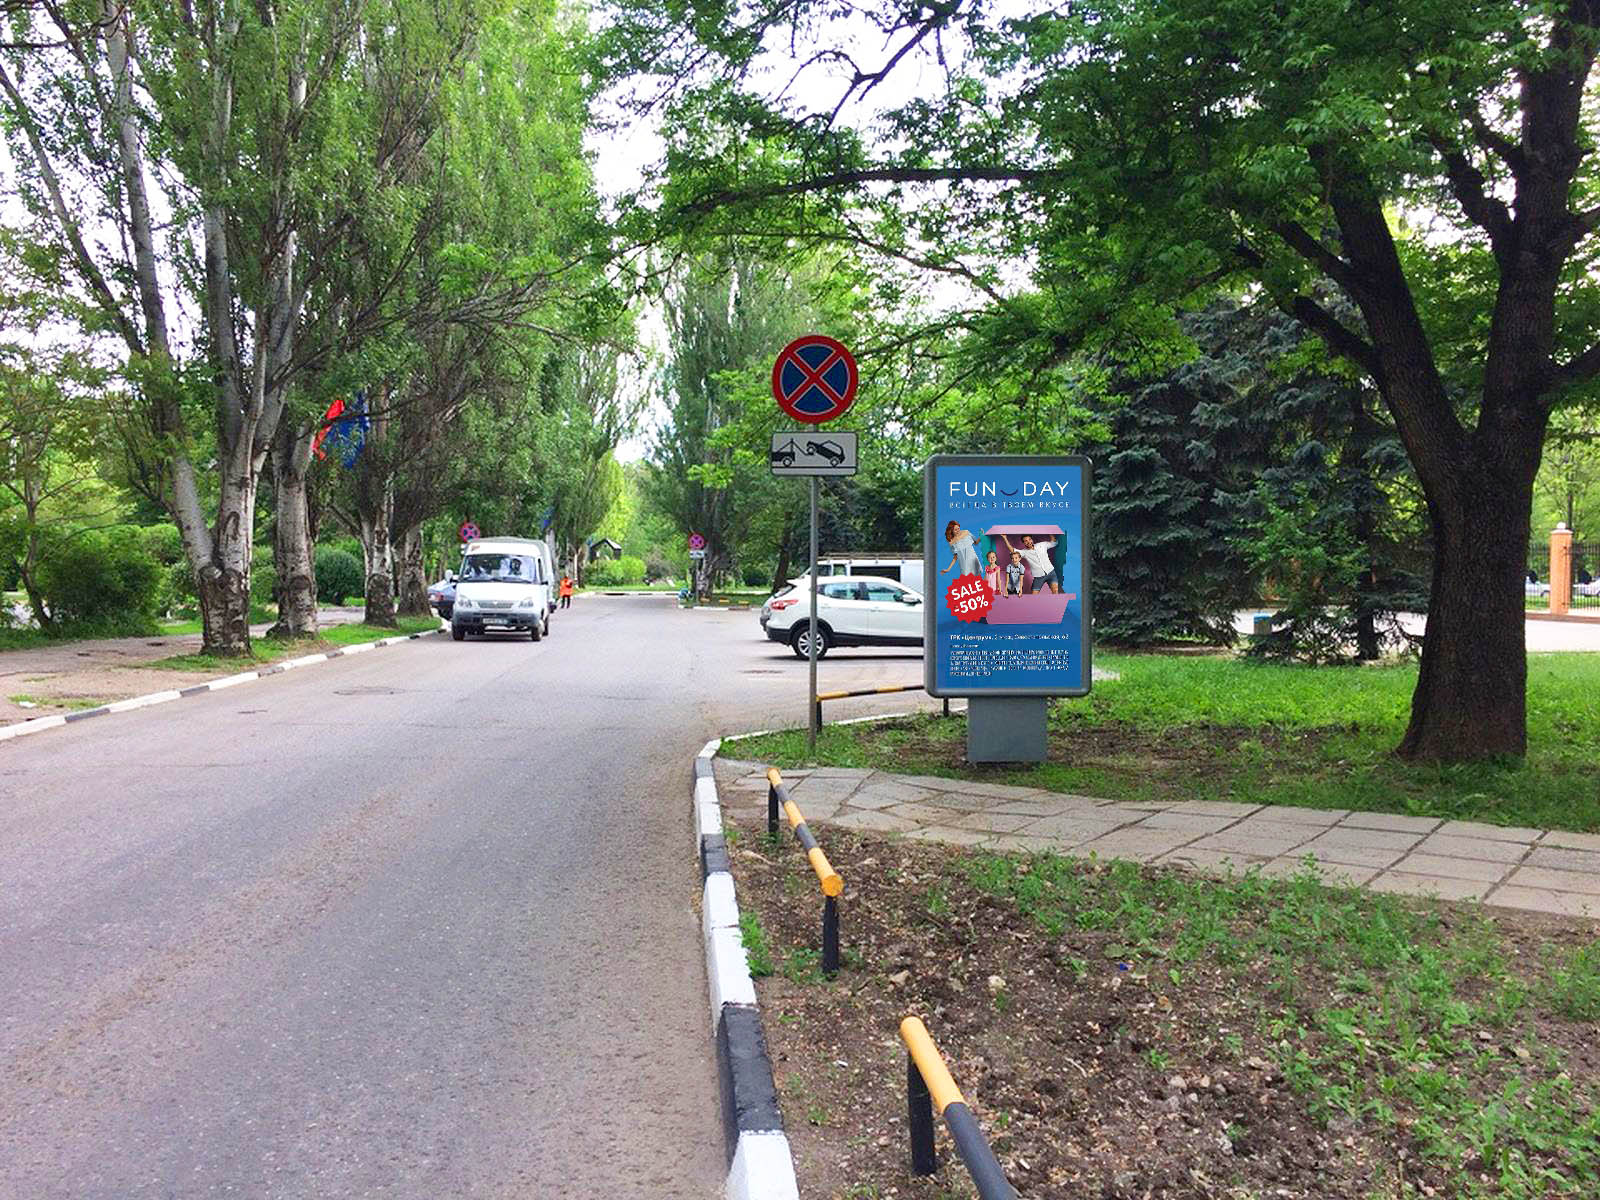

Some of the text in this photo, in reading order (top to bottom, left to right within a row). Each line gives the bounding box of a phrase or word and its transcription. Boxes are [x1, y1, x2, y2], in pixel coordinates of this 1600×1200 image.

[949, 481, 1069, 497] FUN DAY
[951, 580, 983, 600] SALE
[954, 594, 989, 613] -50%
